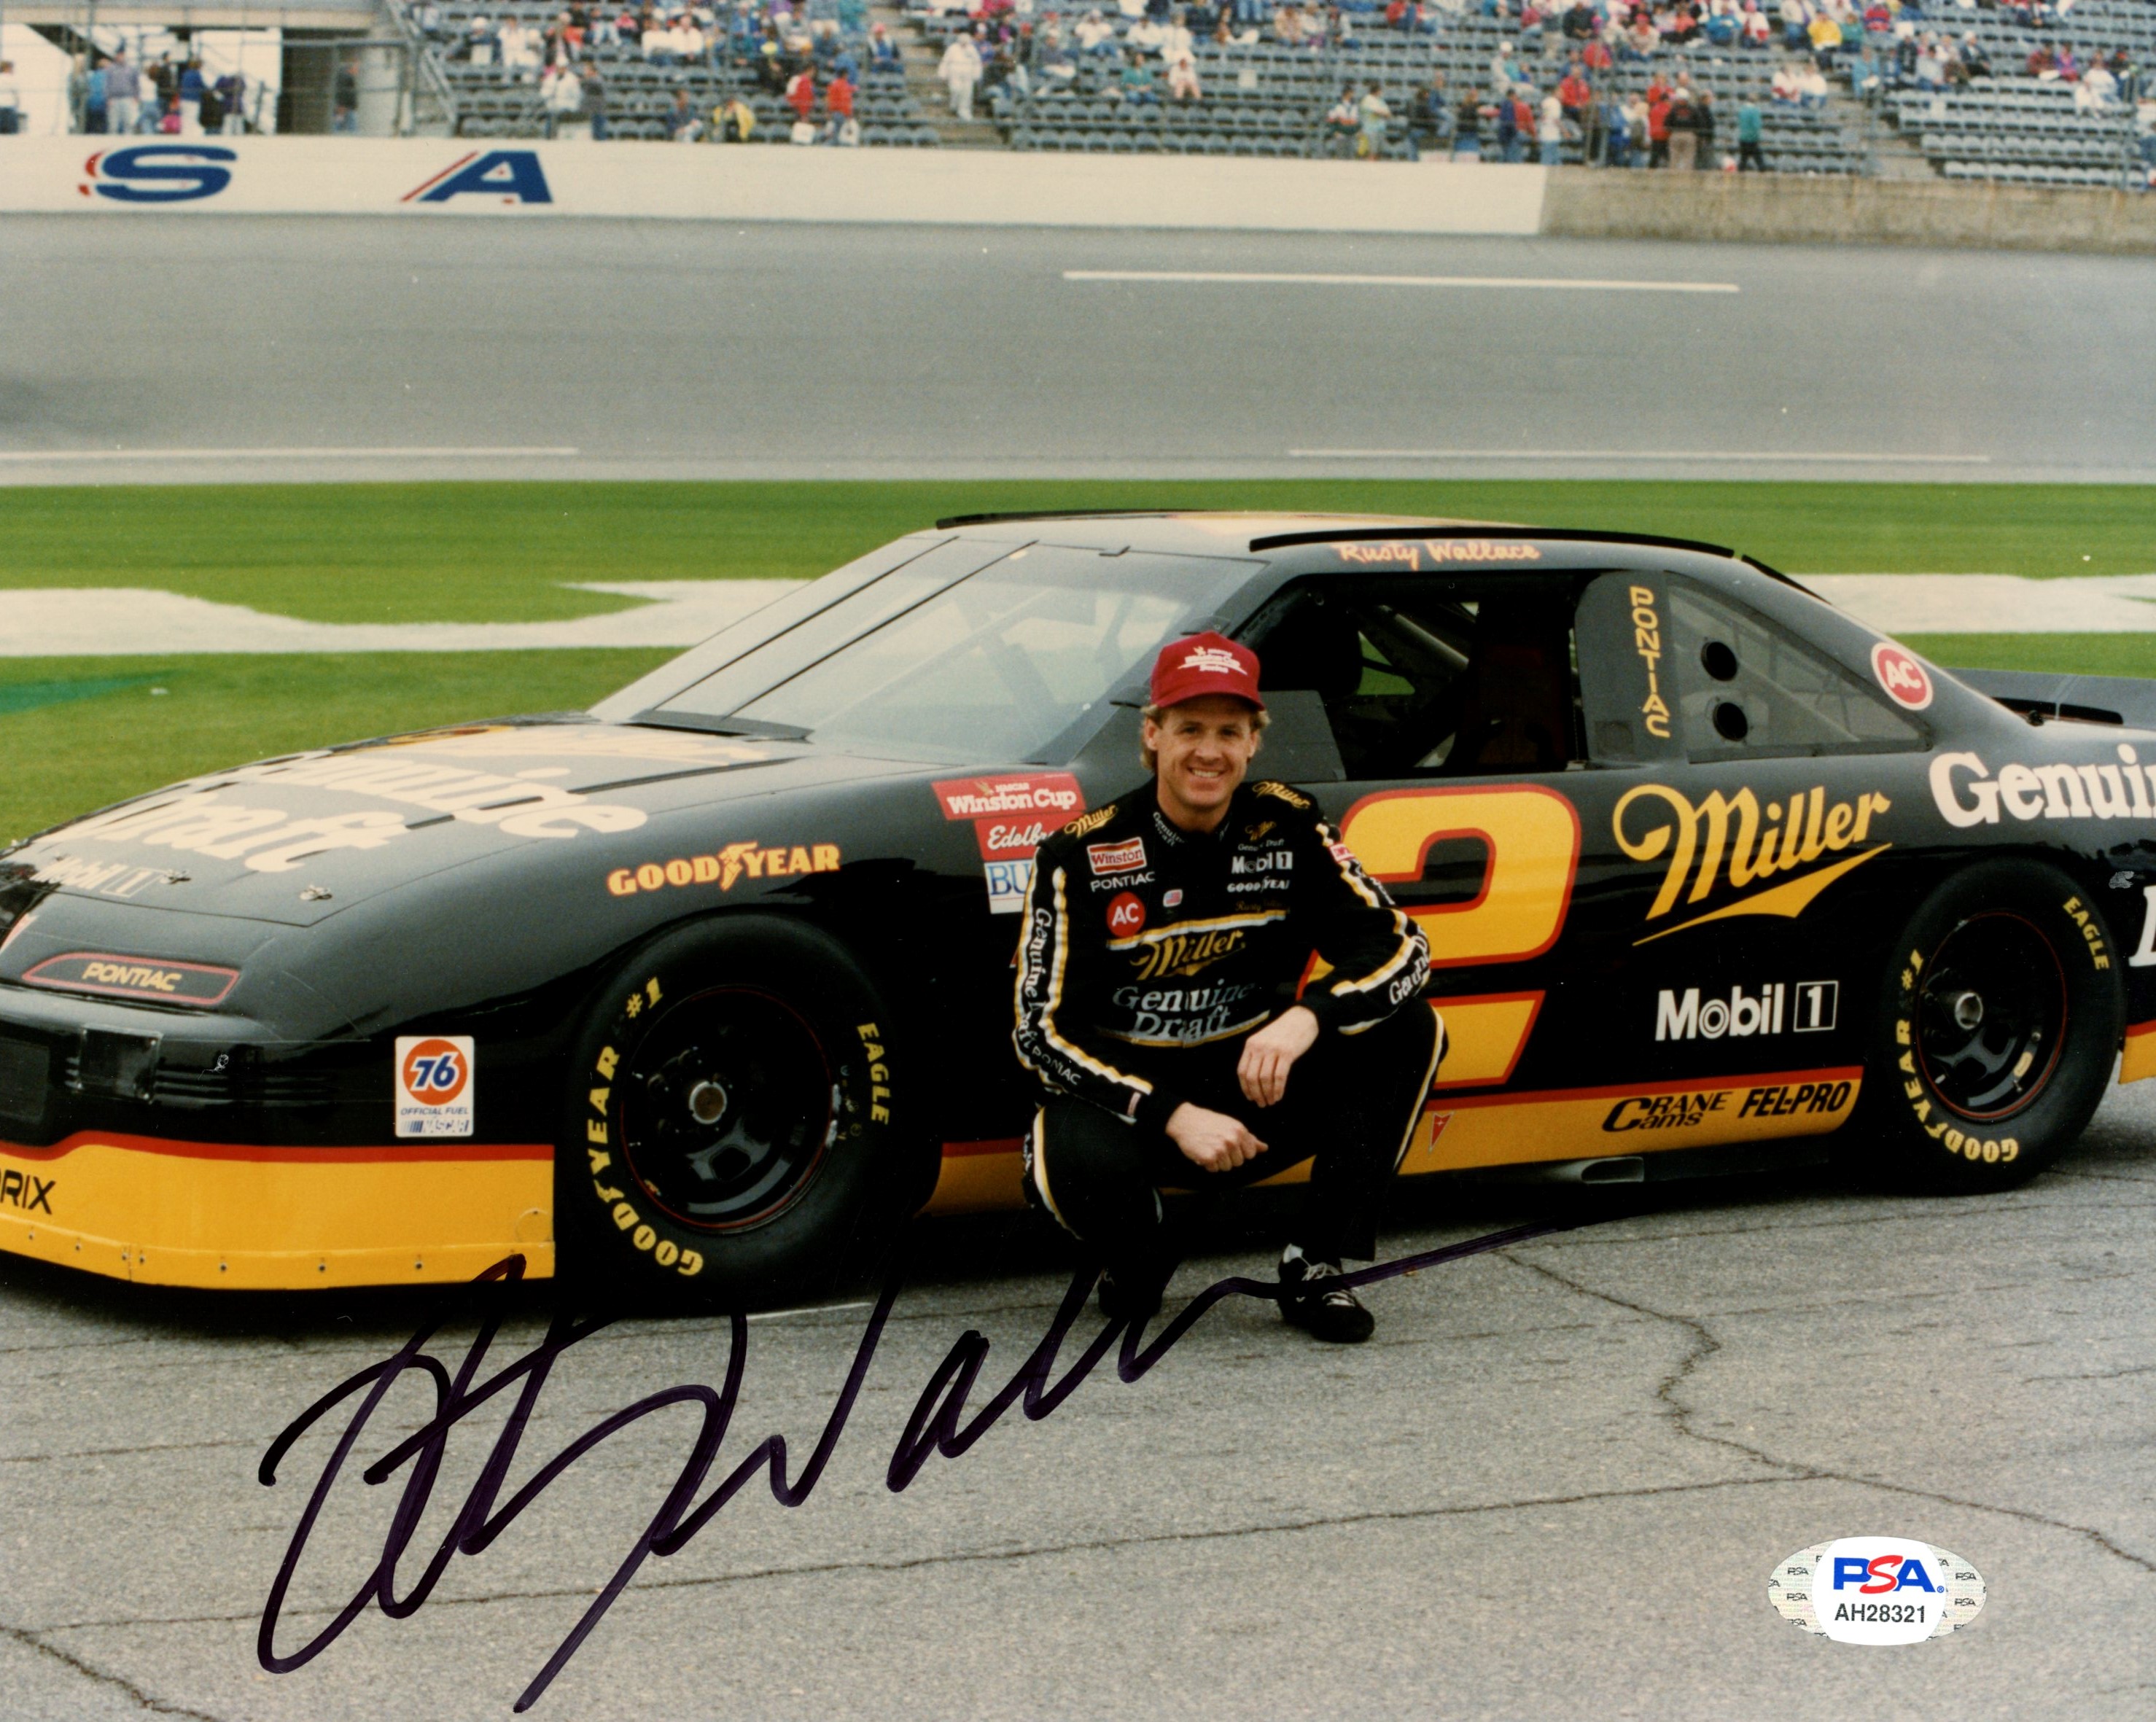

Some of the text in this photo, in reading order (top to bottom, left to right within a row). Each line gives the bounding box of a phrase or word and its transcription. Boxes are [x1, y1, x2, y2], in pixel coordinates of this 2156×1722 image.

[1332, 539, 1541, 572] Rusty Wallace
[1629, 585, 1670, 739] PONTIAC
[1883, 659, 1922, 690] AC
[946, 788, 1077, 814] Winston Cup
[1252, 781, 1311, 809] Miller
[1929, 743, 2156, 828] Genui
[1064, 804, 1117, 838] Miller
[607, 841, 841, 897] GOODYEAR
[1091, 849, 1143, 866] Winston
[1612, 784, 1891, 920] Miller
[1090, 871, 1156, 892] PONTIAC
[1111, 903, 1140, 927] AC
[2062, 896, 2111, 970] EAGLE
[1024, 907, 1053, 999] Genuine
[1130, 930, 1245, 981] Miller
[82, 962, 183, 991] PONTIAC
[1112, 978, 1256, 1012] Genuine
[1132, 1005, 1231, 1040] Draft
[1655, 983, 1784, 1042] Mobil
[410, 1052, 459, 1091] 76
[857, 1022, 892, 1125] EAGLE
[1896, 948, 2019, 1163] GOODYEAR #1
[400, 1107, 470, 1115] OFFICIAL FUEL
[587, 976, 704, 1277] GOODYEAR #1
[1602, 1091, 1734, 1131] CRANE
[0, 1169, 57, 1216] RIX
